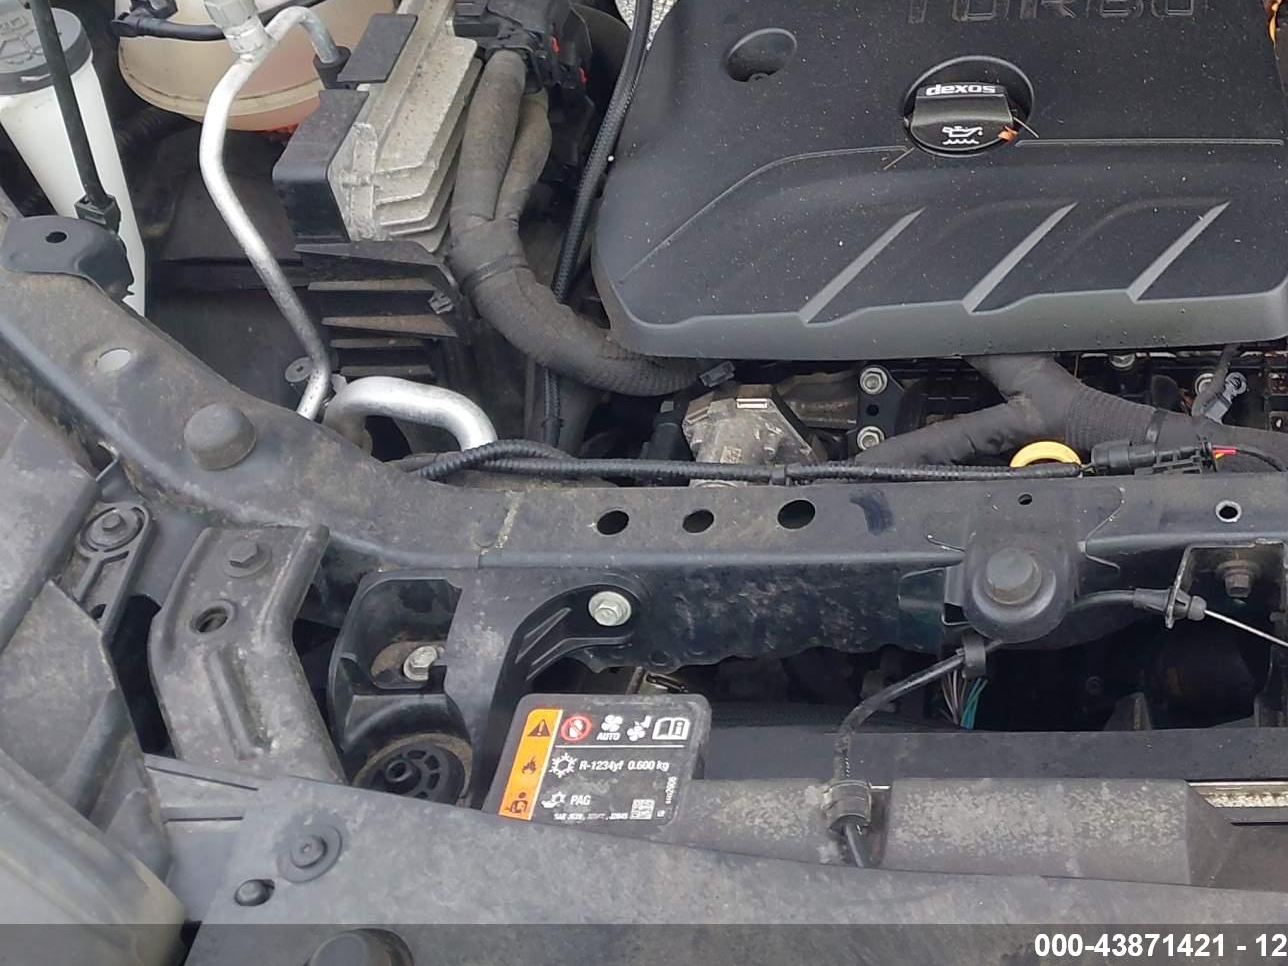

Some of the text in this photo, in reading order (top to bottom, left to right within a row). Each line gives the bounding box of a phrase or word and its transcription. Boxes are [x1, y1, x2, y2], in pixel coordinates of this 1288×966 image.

[925, 84, 996, 97] dexos
[597, 732, 621, 741] AUTO
[579, 760, 625, 772] R-1234yf
[656, 761, 670, 772] kg
[570, 794, 591, 805] PAG
